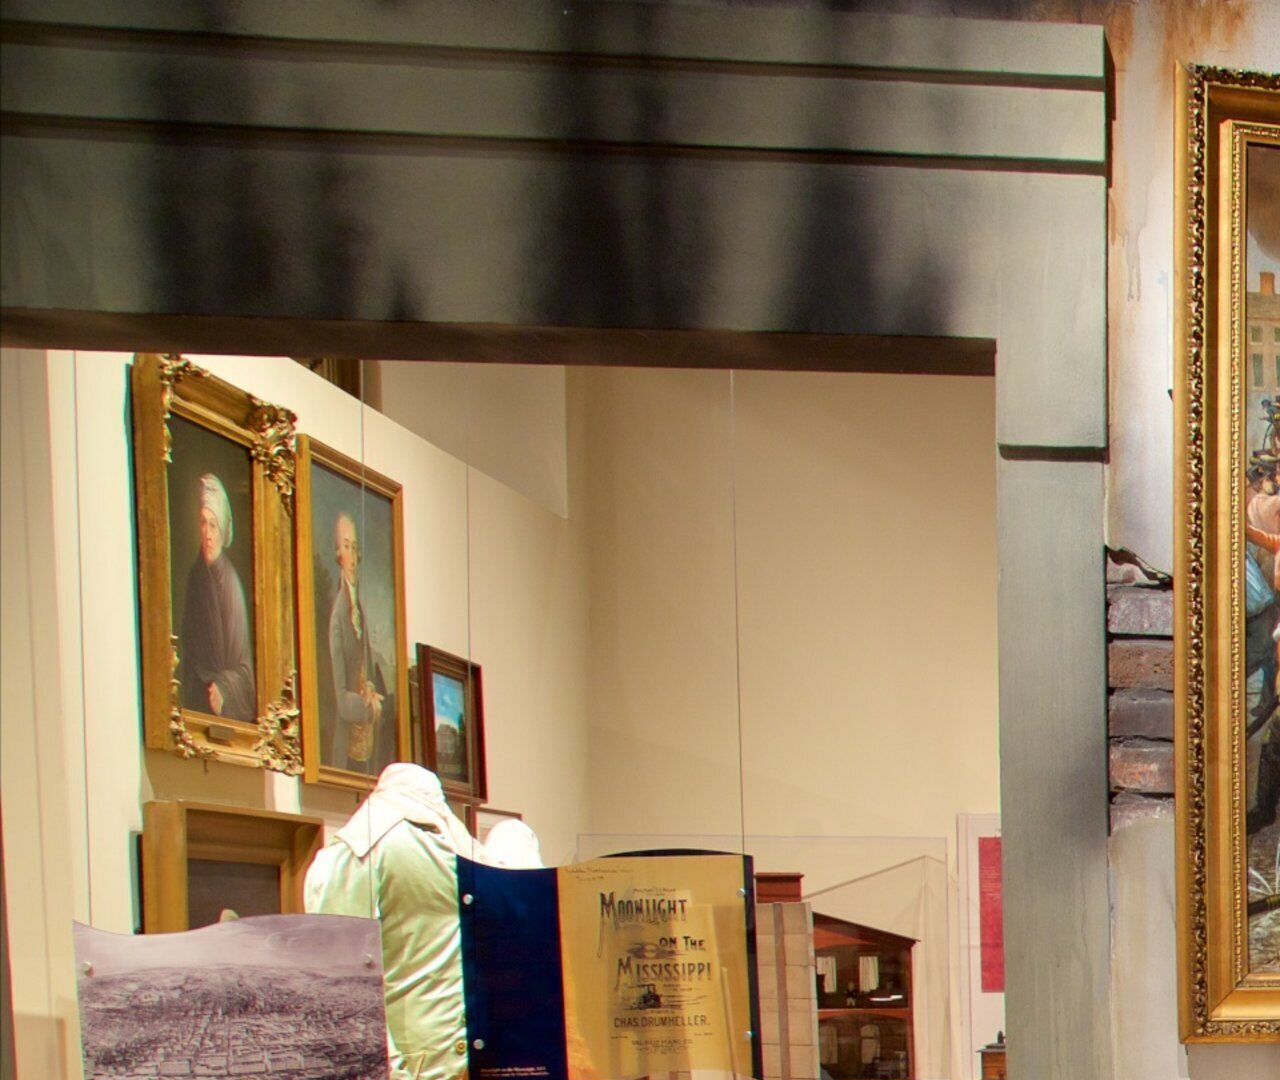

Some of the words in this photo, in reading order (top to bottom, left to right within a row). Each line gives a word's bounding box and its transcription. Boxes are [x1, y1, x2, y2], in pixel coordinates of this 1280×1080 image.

[658, 937, 678, 947] ON
[683, 936, 706, 950] THE
[615, 957, 712, 983] MISSISSIPPI
